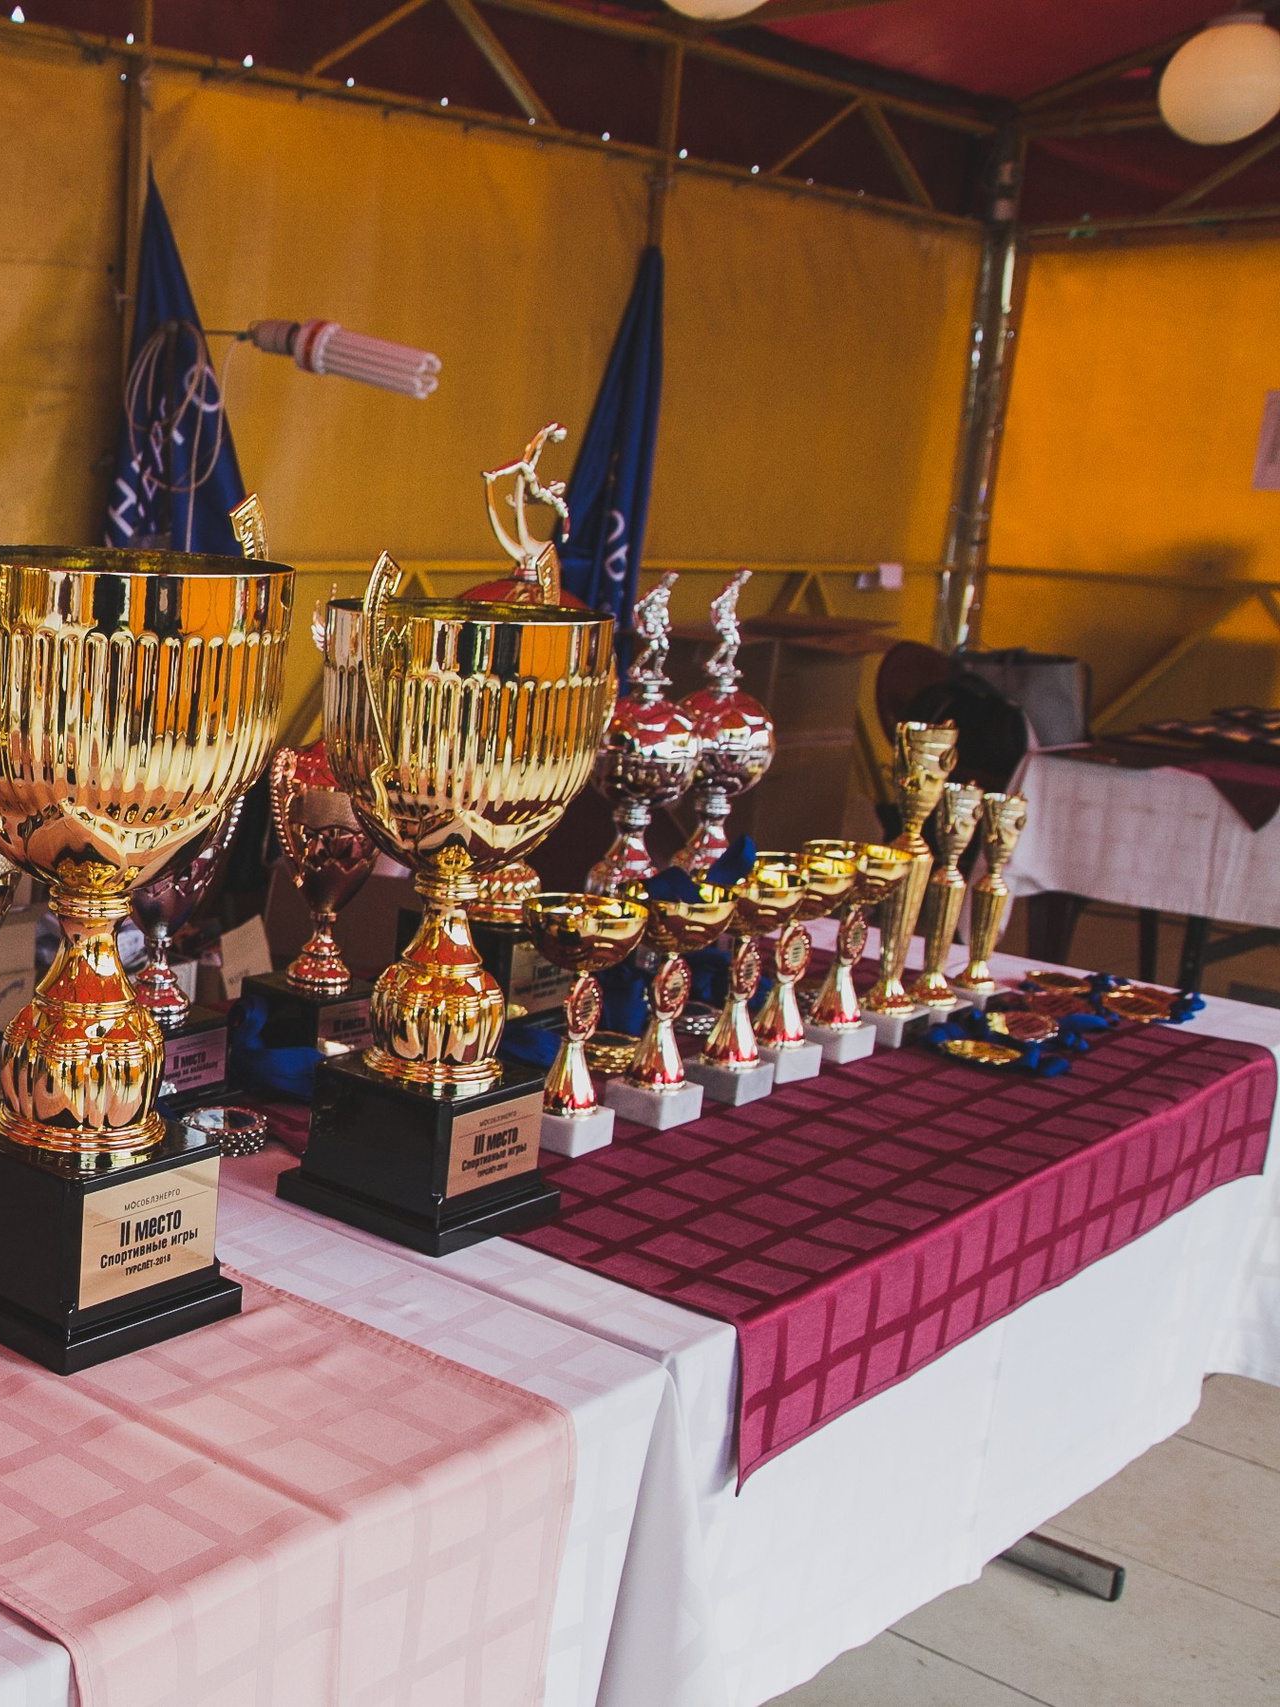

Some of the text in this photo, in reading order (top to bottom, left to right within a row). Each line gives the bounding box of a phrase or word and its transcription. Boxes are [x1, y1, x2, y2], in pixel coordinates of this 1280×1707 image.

[474, 1127, 518, 1155] III место
[508, 1143, 528, 1157] игры
[124, 1187, 181, 1212] МОСОБЛЭНЕРГО
[119, 1209, 182, 1248] II место
[100, 1227, 199, 1270] Спортивные игры
[125, 1253, 172, 1276] ТУРСЛЁТ-2018
